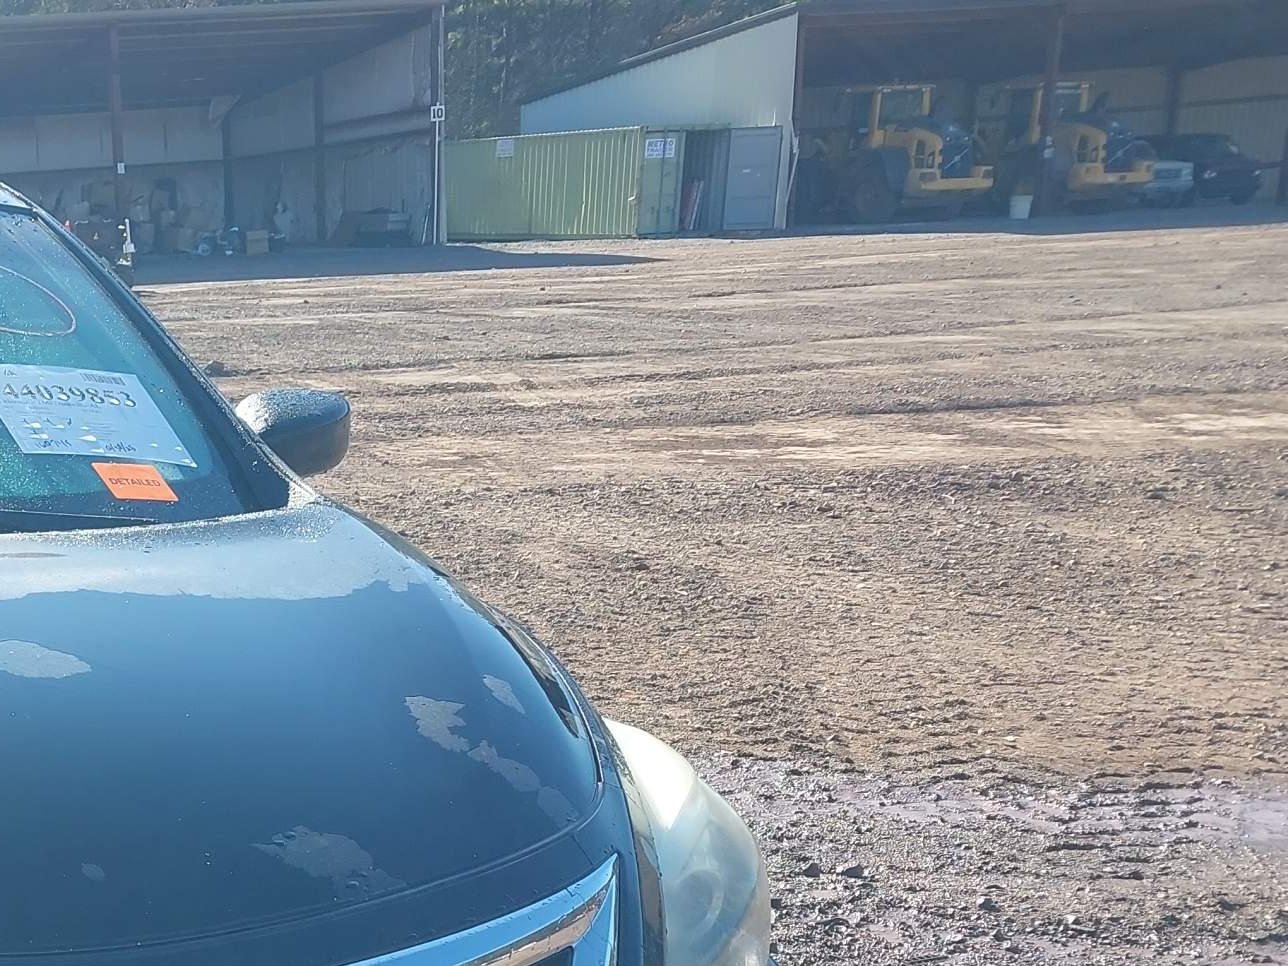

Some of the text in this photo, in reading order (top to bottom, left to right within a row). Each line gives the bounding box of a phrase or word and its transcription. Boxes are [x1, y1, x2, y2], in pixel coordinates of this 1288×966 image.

[432, 108, 443, 119] 10
[2, 383, 137, 408] 44039853
[108, 477, 161, 487] DETAILED
